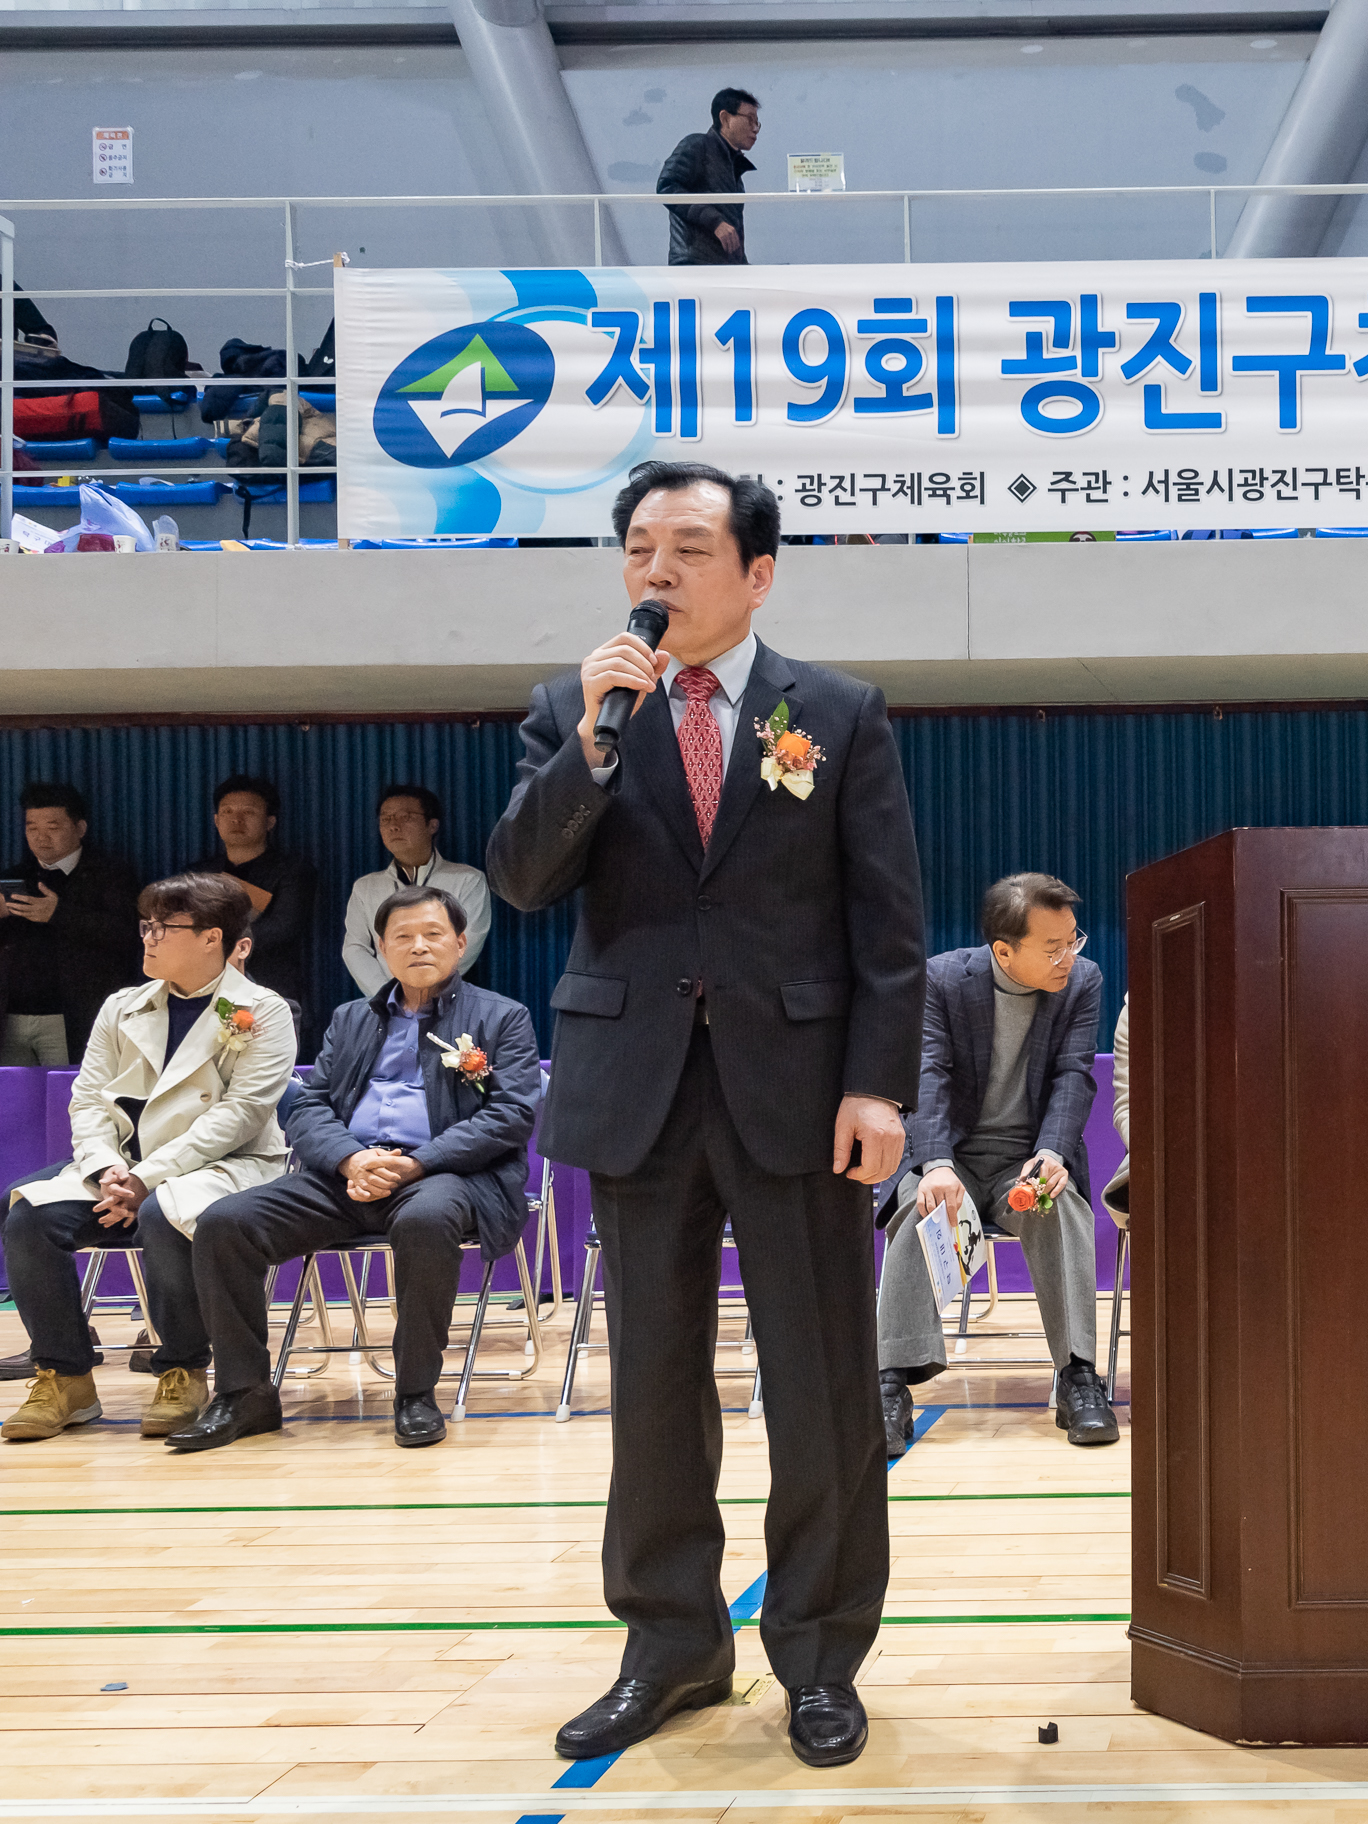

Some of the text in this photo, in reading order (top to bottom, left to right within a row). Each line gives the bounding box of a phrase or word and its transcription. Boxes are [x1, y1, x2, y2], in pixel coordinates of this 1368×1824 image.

[584, 294, 957, 438] 제19회
[794, 471, 985, 507] 광진구체육회
[1047, 469, 1112, 504] 주관
